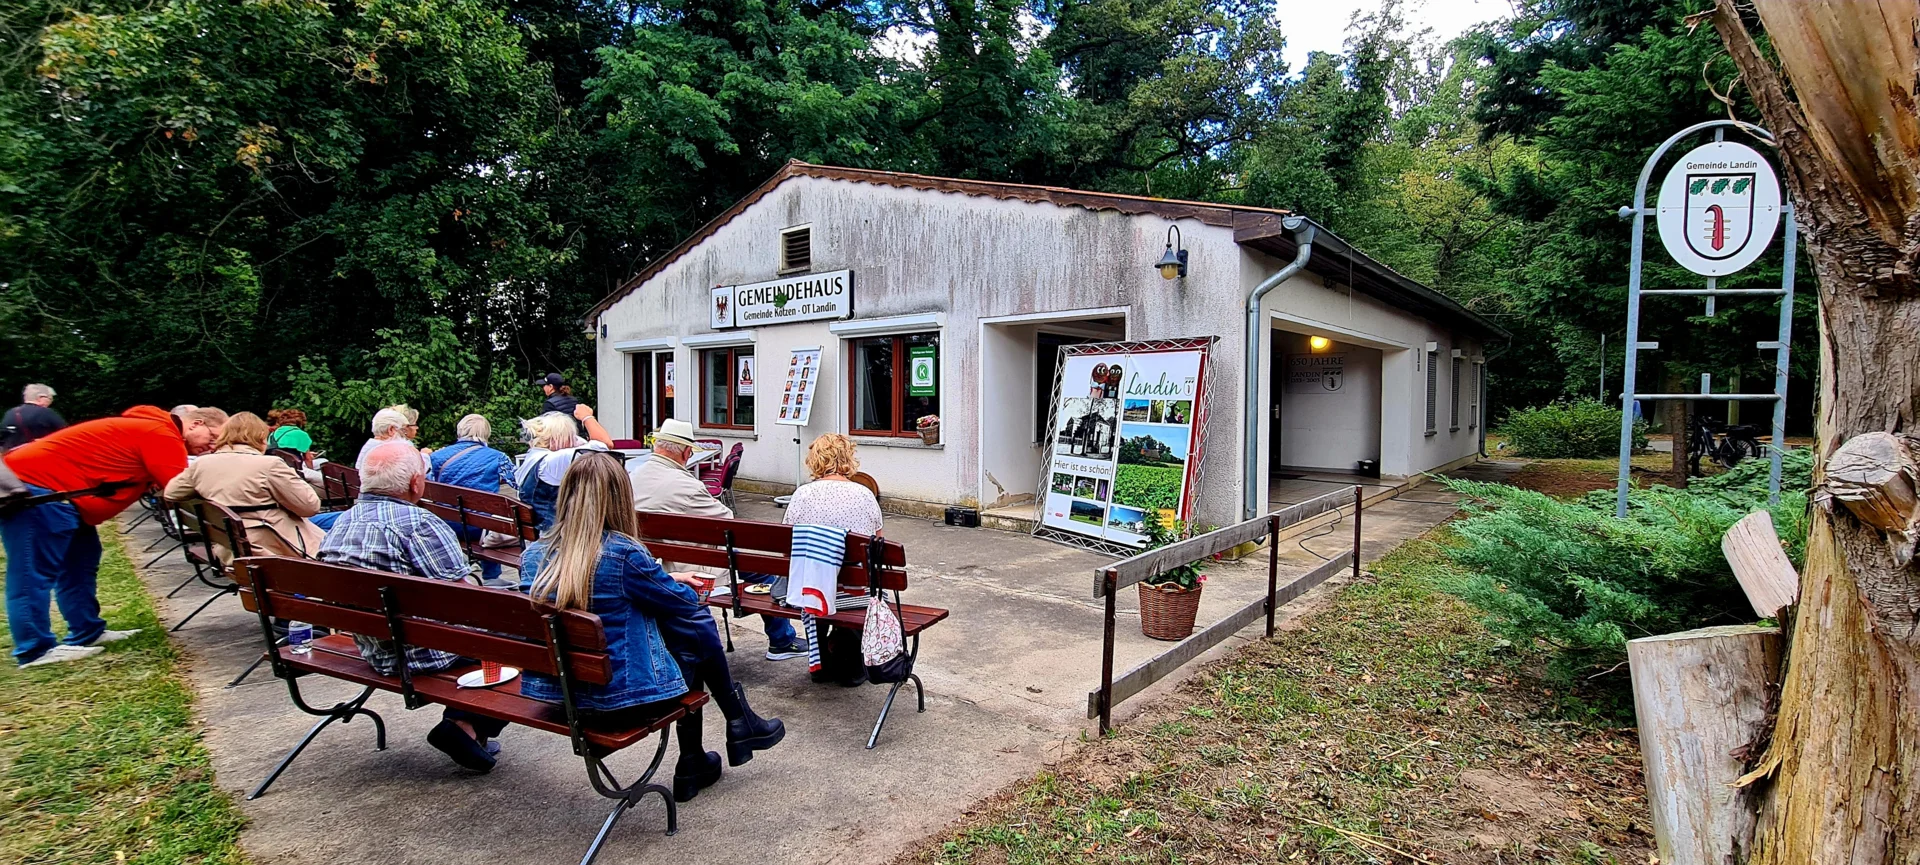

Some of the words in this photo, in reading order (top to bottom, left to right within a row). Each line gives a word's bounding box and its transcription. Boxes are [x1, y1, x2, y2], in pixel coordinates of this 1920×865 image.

[1730, 161, 1757, 169] Landin
[738, 277, 843, 307] GEMEINDEHAUS
[743, 309, 773, 320] Gemeinde
[801, 305, 811, 315] OT
[812, 302, 836, 313] Landin
[1290, 357, 1308, 366] 650
[1310, 357, 1343, 367] JAHRE
[919, 367, 926, 378] K
[1126, 372, 1181, 395] Landin
[1054, 459, 1070, 470] Hier
[1070, 461, 1079, 471] ist
[1080, 464, 1088, 472] es
